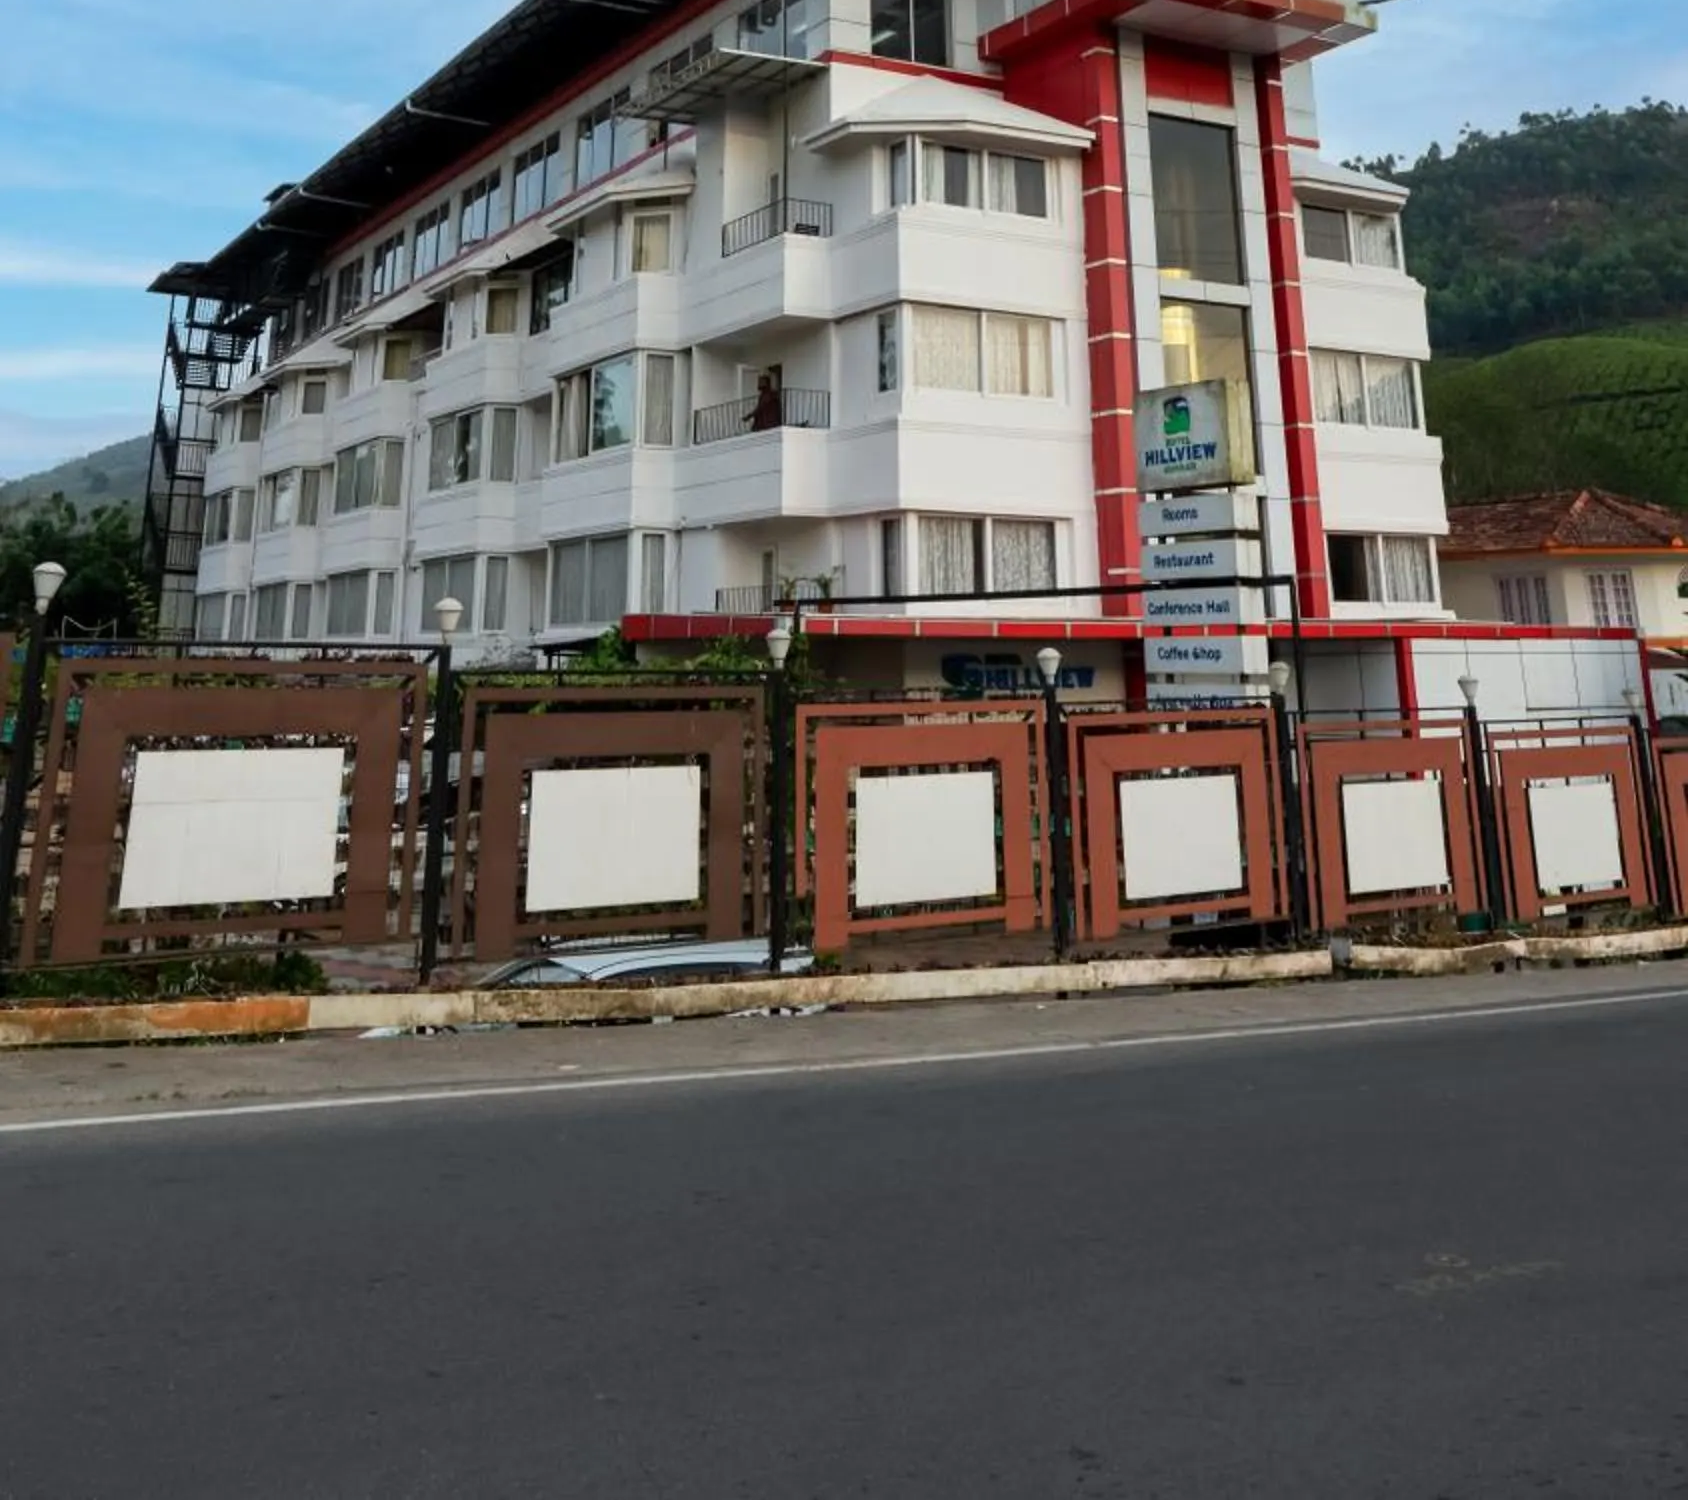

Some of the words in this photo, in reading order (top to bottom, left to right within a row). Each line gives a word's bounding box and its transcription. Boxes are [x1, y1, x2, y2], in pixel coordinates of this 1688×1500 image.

[1145, 442, 1217, 466] HILLVIEW
[1162, 508, 1198, 522] Rooms
[1154, 551, 1214, 569] Restaurant
[1148, 601, 1202, 616] Conference
[1206, 600, 1230, 613] Hall
[1158, 646, 1189, 660] Coffee
[985, 667, 1094, 691] HILLEW
